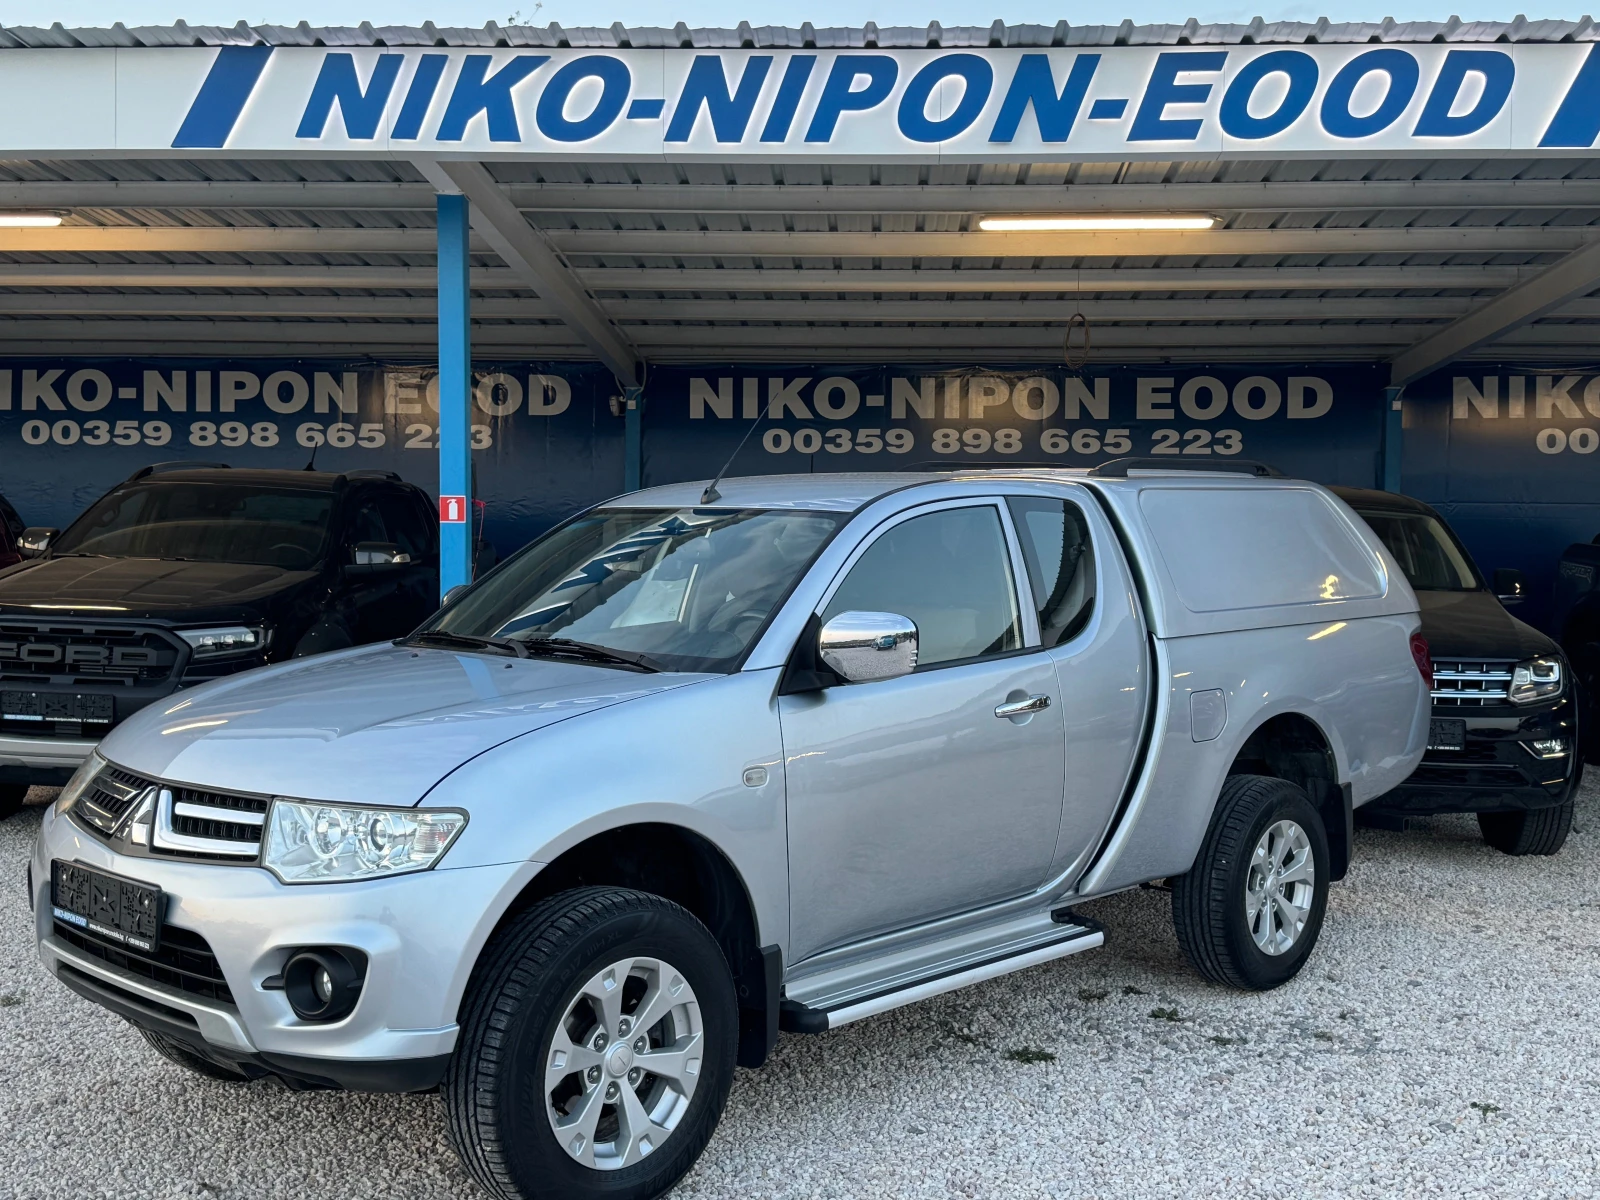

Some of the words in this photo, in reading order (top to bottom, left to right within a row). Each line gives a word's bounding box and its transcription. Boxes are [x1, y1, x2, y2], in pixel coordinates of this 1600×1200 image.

[296, 49, 1515, 143] NIKO-NIPON-EOOD
[384, 372, 571, 417] EOD
[690, 376, 1110, 420] NIKO-NIPON
[1136, 375, 1334, 420] EOOD
[21, 419, 172, 446] 00359
[188, 421, 280, 447] 898
[295, 422, 386, 448] 665
[404, 423, 493, 449] 23
[762, 428, 915, 454] 00359
[931, 428, 1023, 454] 898
[1040, 428, 1132, 454] 665
[1151, 429, 1244, 455] 223
